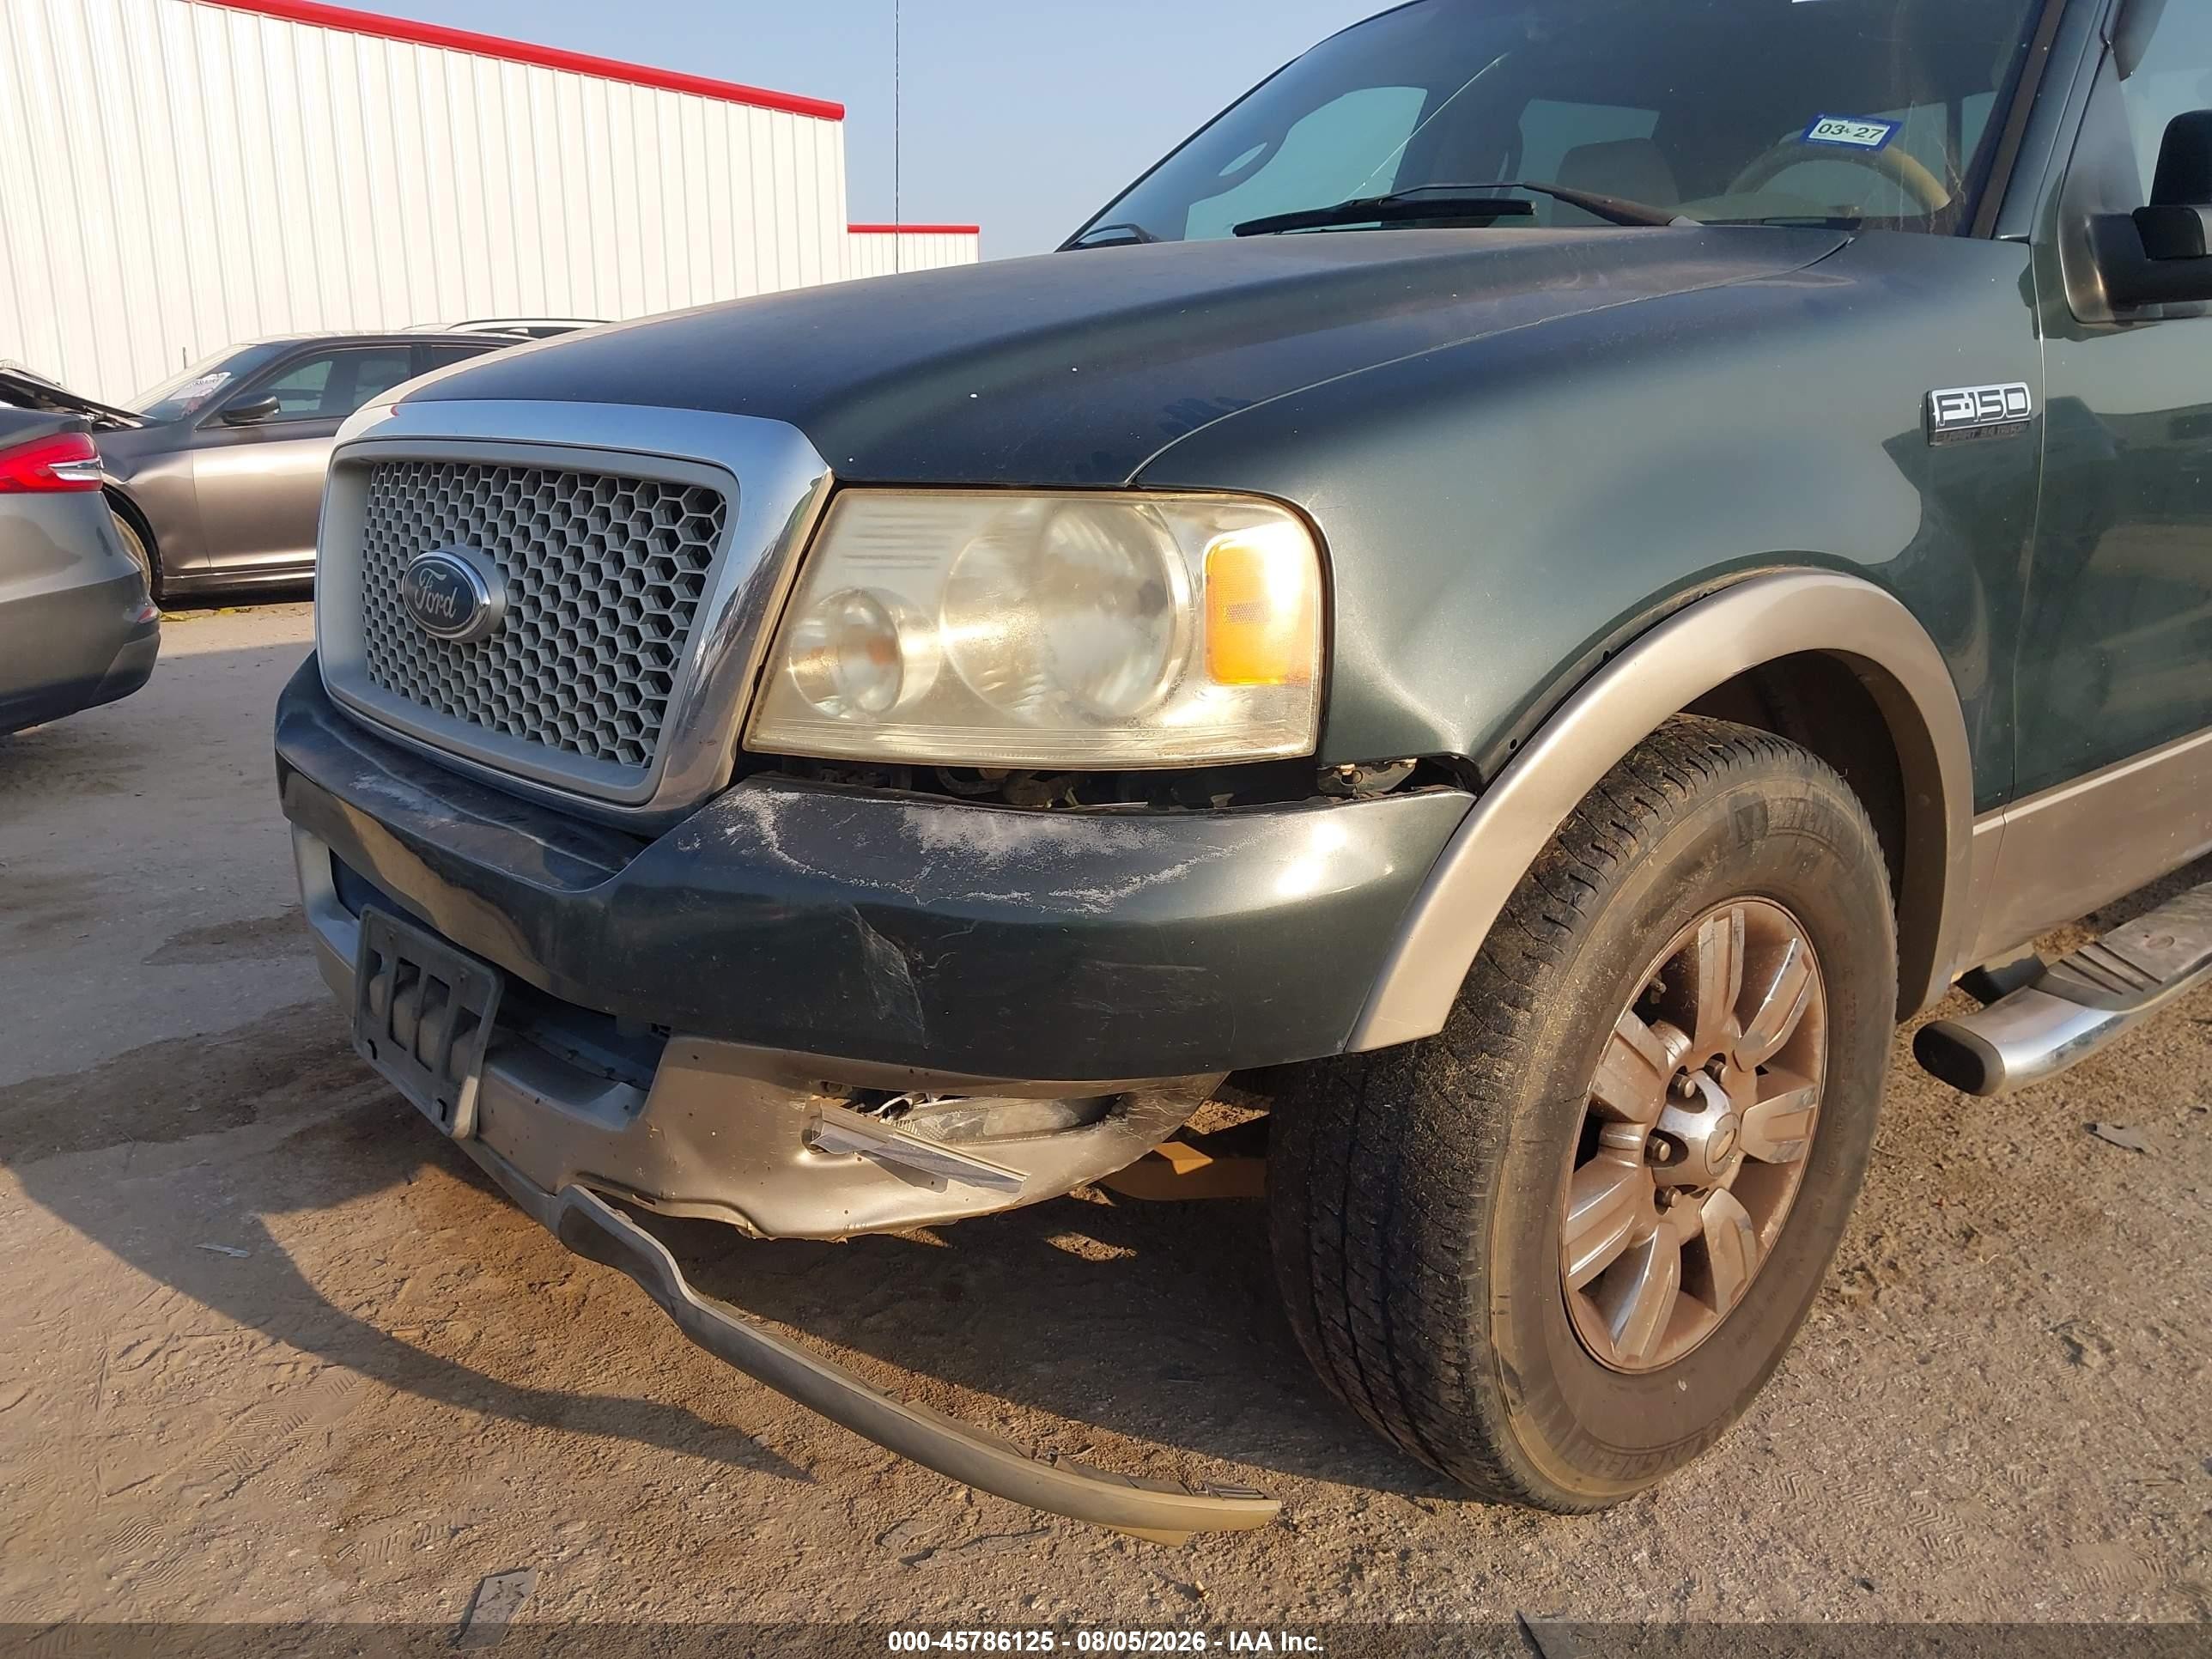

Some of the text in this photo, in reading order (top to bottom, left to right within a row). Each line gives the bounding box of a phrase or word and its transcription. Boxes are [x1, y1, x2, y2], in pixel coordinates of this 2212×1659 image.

[1817, 123, 1885, 140] 03 27
[414, 567, 459, 619] Ford
